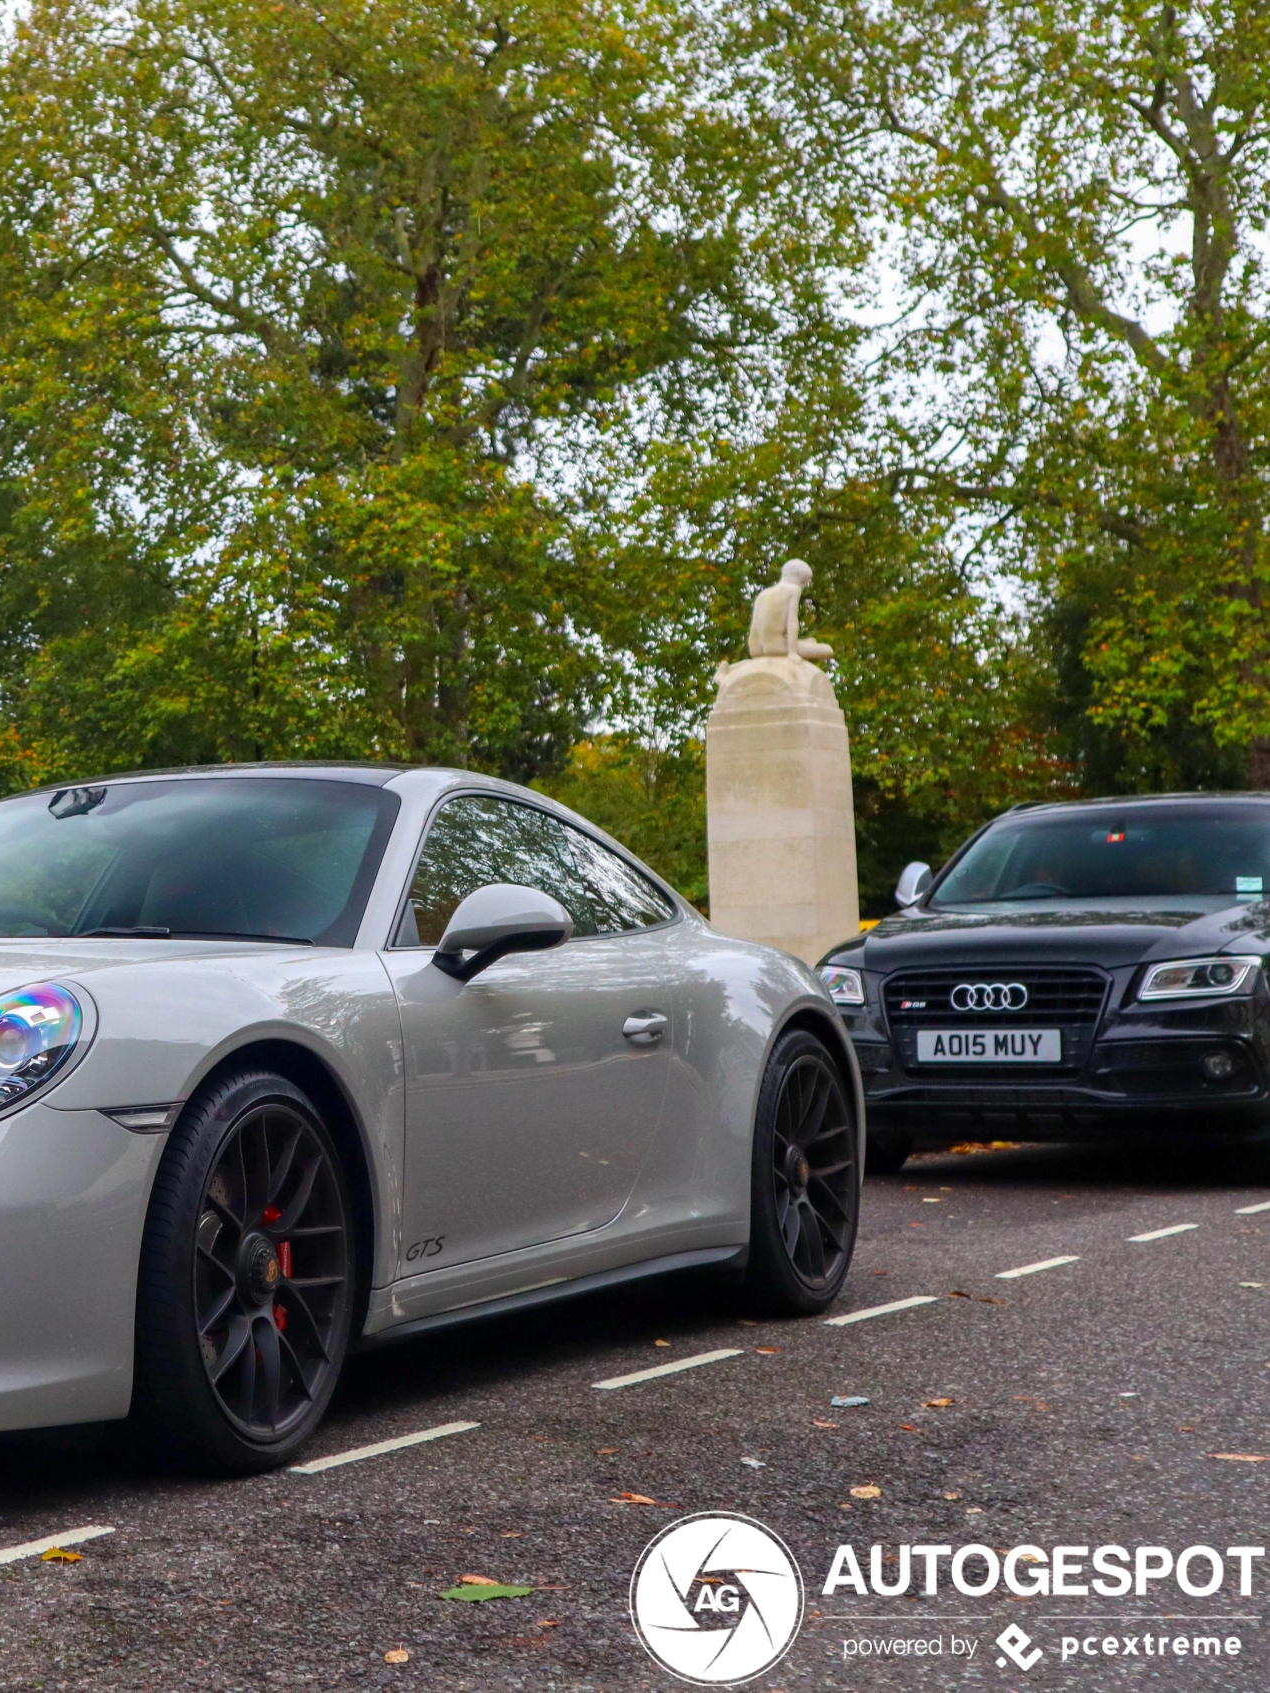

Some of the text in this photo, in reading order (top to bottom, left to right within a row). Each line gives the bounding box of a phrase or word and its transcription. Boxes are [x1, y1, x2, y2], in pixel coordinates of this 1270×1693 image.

[933, 1033, 1043, 1056] AO15 MUY
[406, 1236, 446, 1261] GTS
